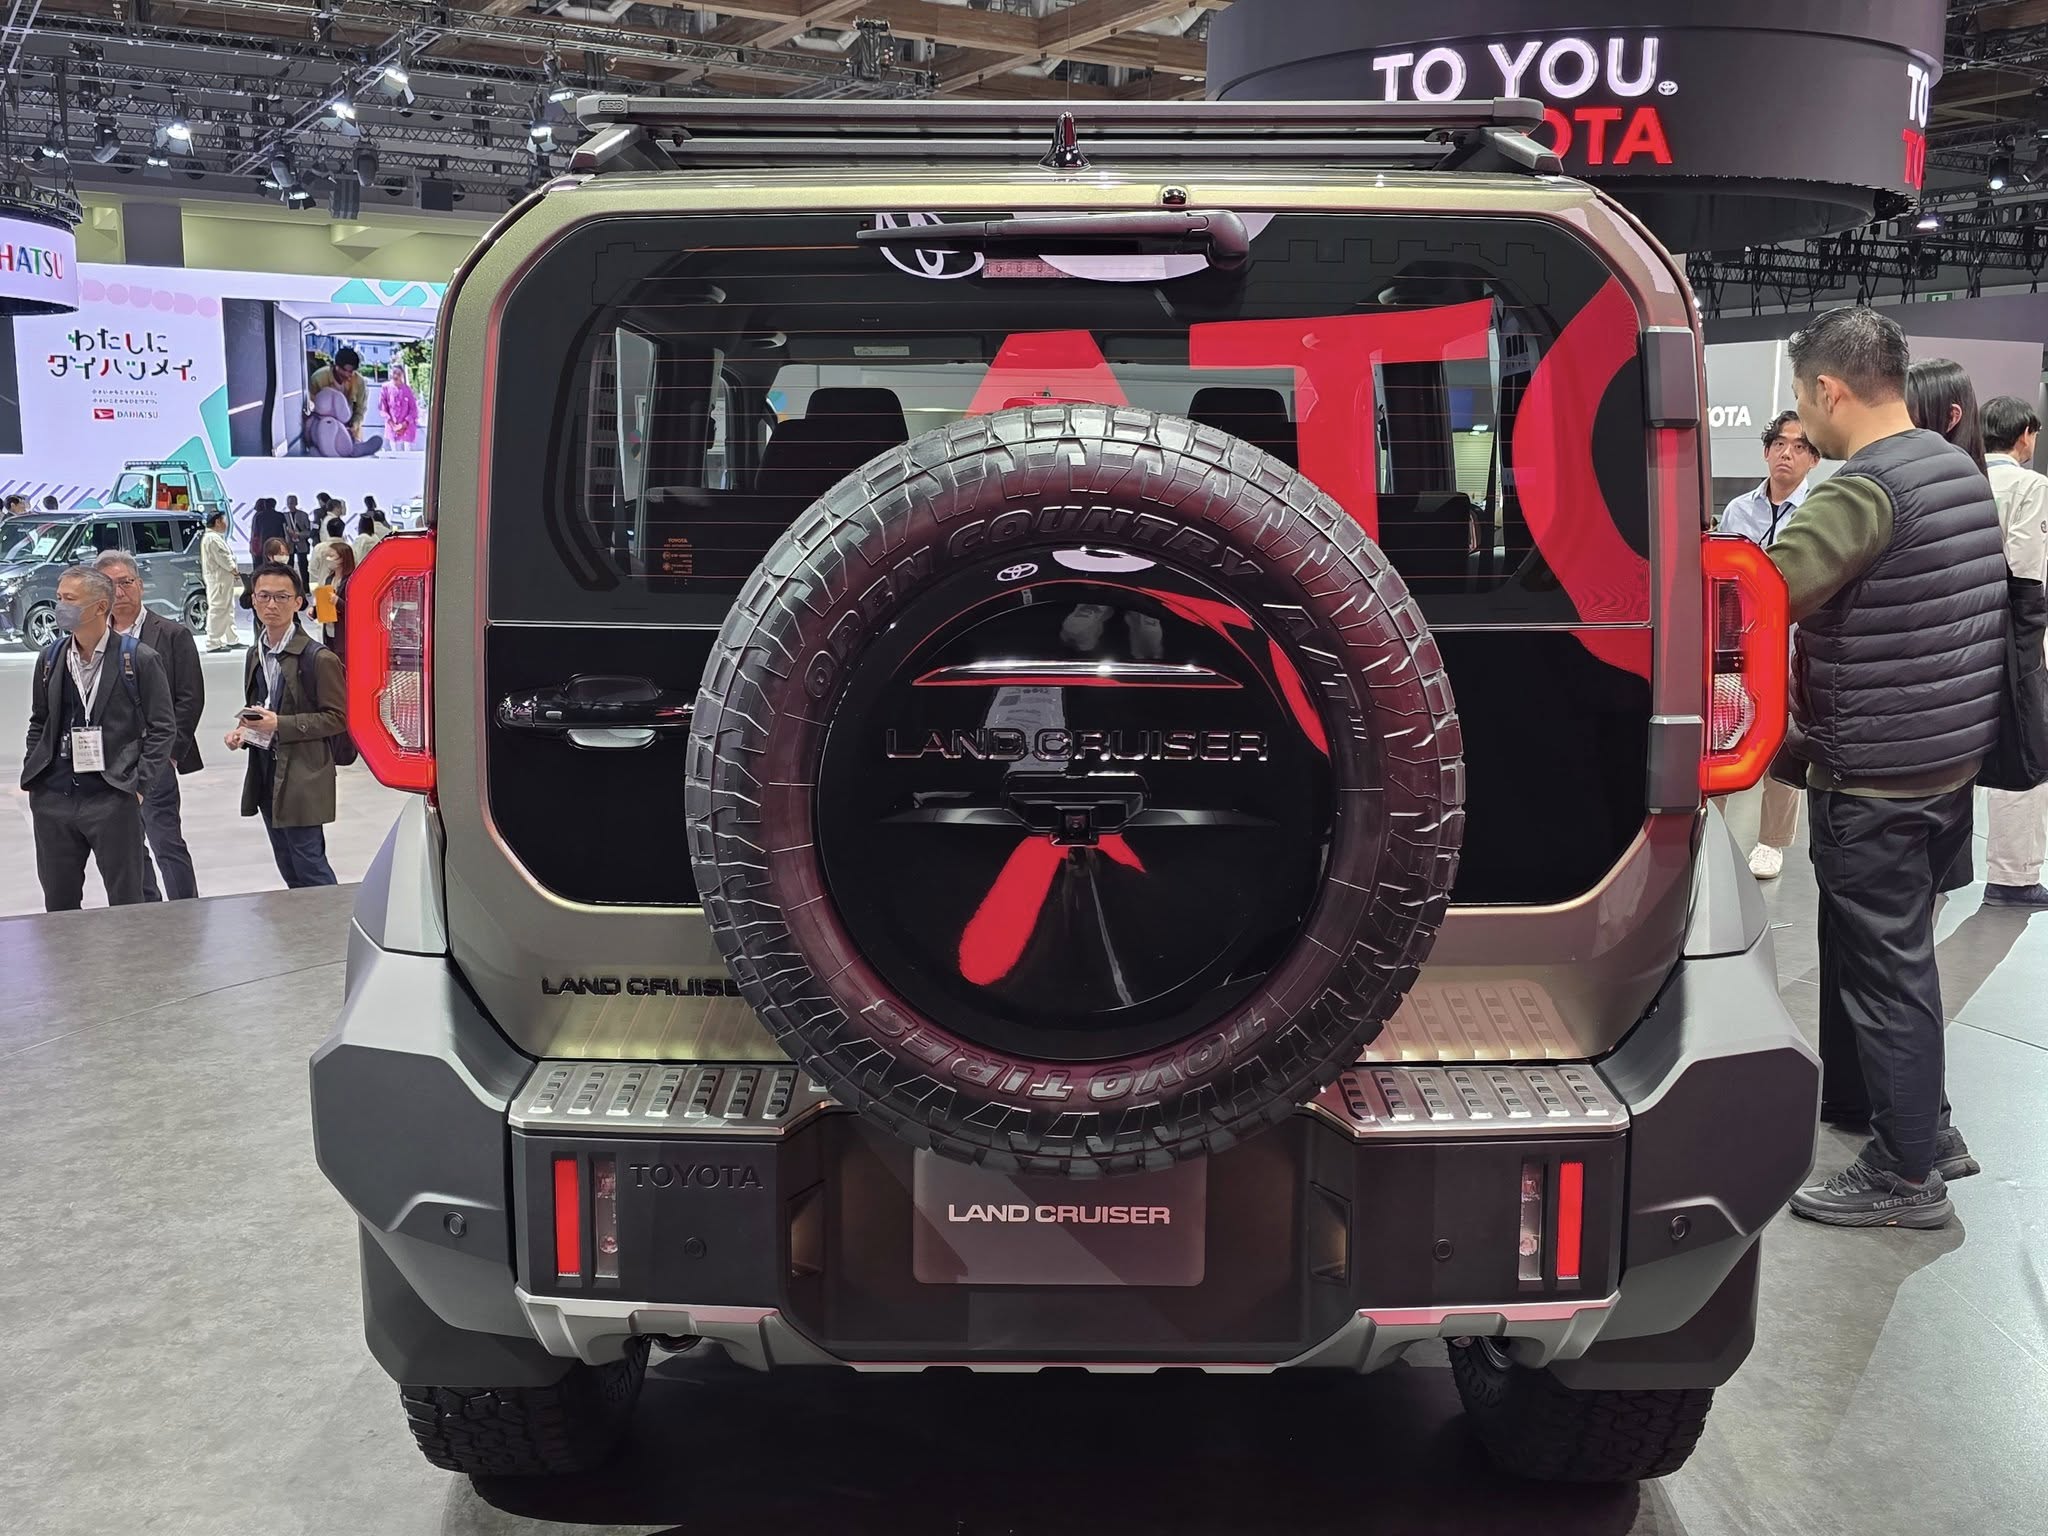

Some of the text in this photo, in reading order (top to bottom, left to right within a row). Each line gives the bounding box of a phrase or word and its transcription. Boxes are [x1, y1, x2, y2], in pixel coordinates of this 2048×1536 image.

[1373, 47, 1467, 101] TO
[1907, 63, 1929, 128] TO
[1903, 129, 1926, 190] TO
[67, 328, 168, 355] わたしに
[117, 410, 159, 419] DAIHATSU
[803, 545, 936, 699] OPEN
[946, 505, 1264, 578] COUNTRY
[885, 728, 1270, 763] LAND CRUISER
[541, 976, 622, 997] LAND
[629, 1163, 764, 1190] TOYOTA
[1872, 1190, 1936, 1210] MERRELL
[948, 1203, 1171, 1225] LAND CRUISER
